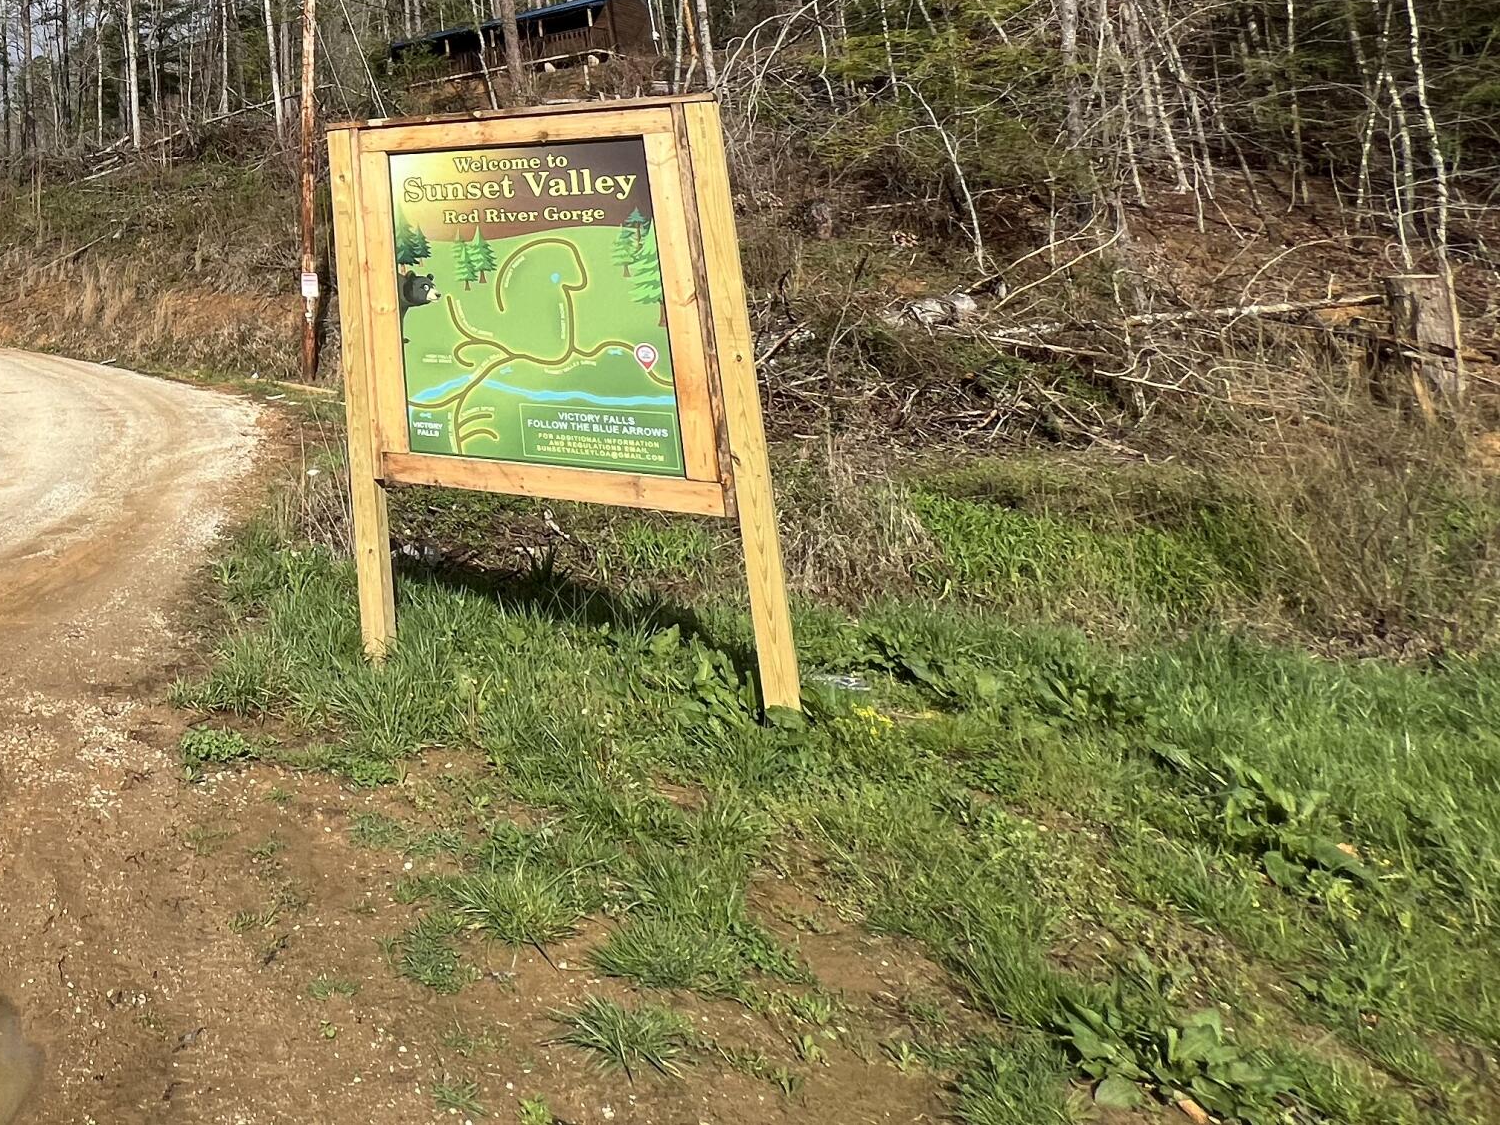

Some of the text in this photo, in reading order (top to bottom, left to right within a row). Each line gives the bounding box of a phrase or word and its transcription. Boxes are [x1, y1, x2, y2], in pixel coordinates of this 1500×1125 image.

[453, 153, 568, 173] Welcome to
[403, 168, 637, 203] Sunset Valley
[443, 206, 605, 224] Red River Gorge
[413, 421, 442, 430] VICTORY
[557, 411, 635, 425] VICTORY FALLS
[417, 429, 440, 437] FALLS
[527, 419, 668, 438] FOLLOW THE BLUE ARROWS
[549, 439, 649, 454] AND REGULATIONS EMAIL
[556, 434, 602, 444] ADDITIONAL
[604, 438, 660, 449] INFORMATION
